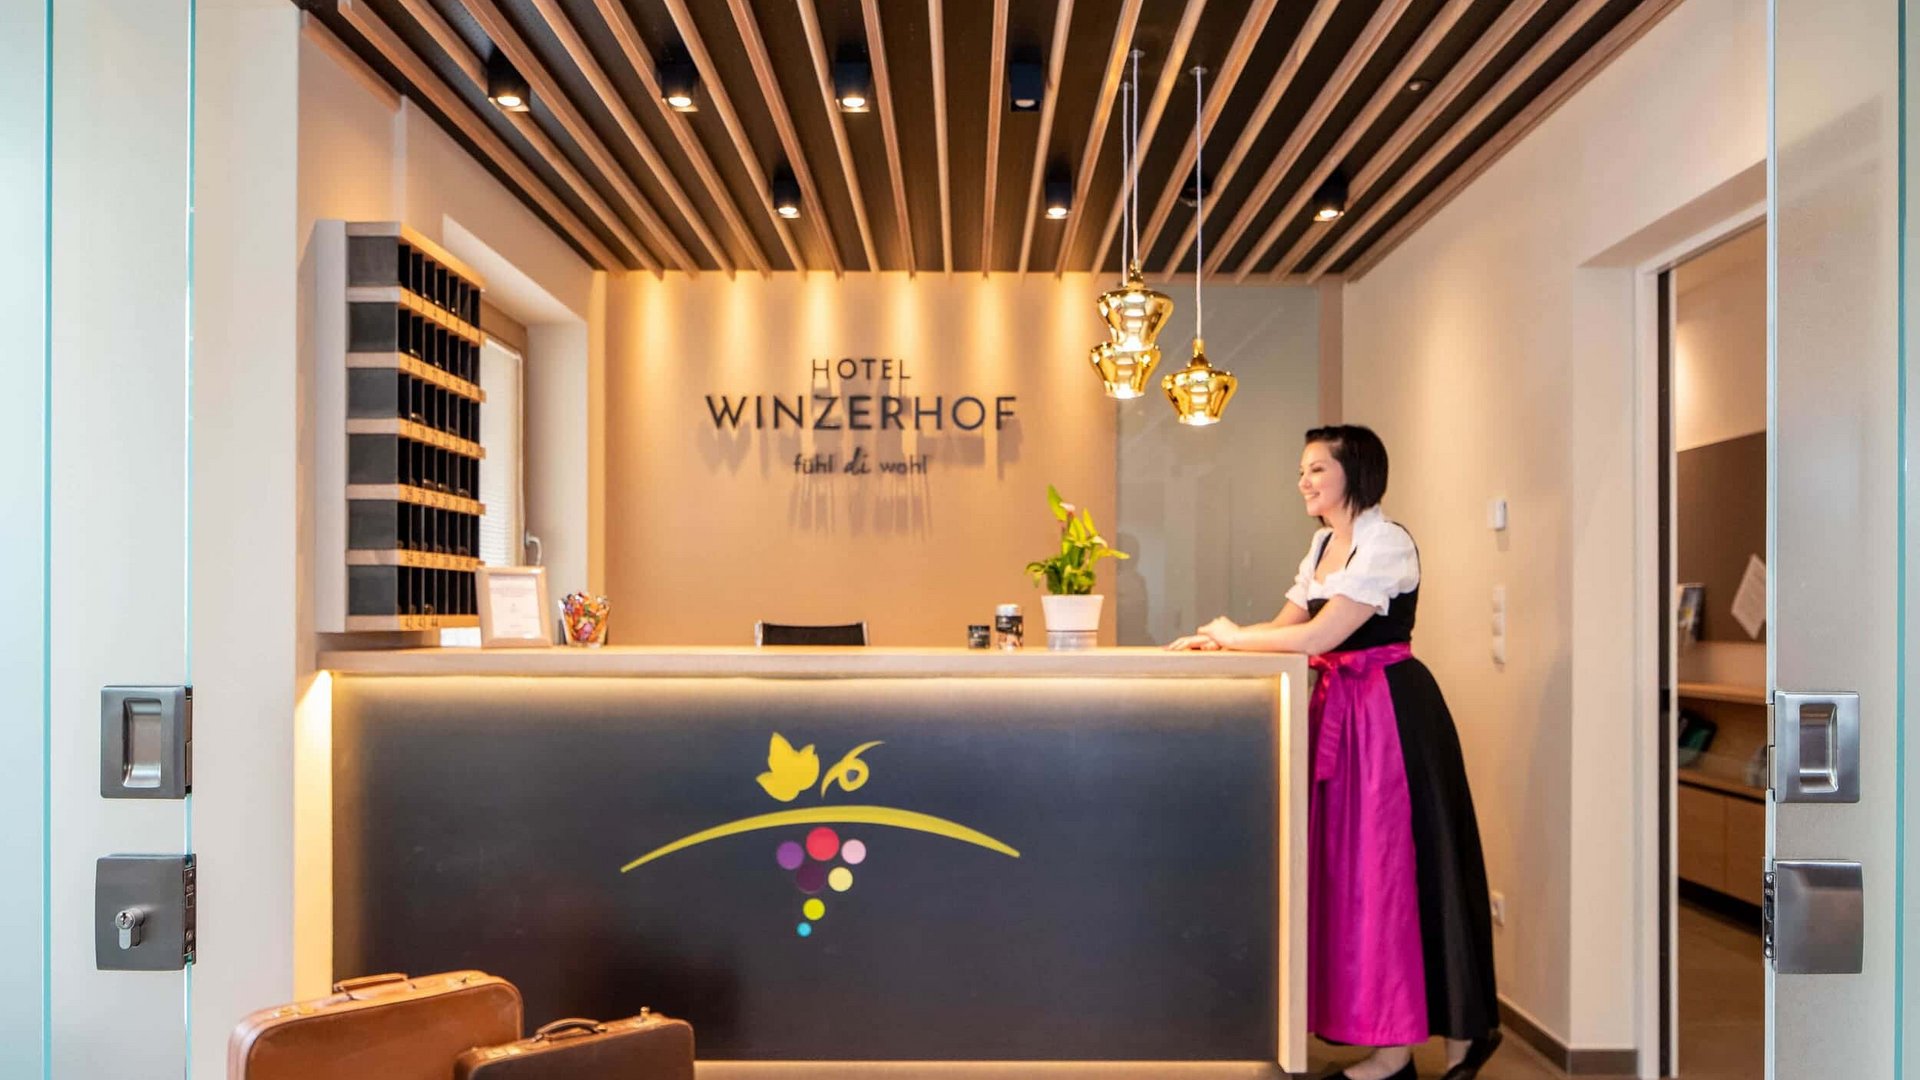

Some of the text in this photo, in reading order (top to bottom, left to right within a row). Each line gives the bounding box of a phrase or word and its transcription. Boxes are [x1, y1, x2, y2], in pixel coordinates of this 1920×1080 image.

[811, 358, 911, 380] HOTEL
[705, 395, 1017, 431] WINZERHOF
[793, 446, 927, 475] fühl di wohl
